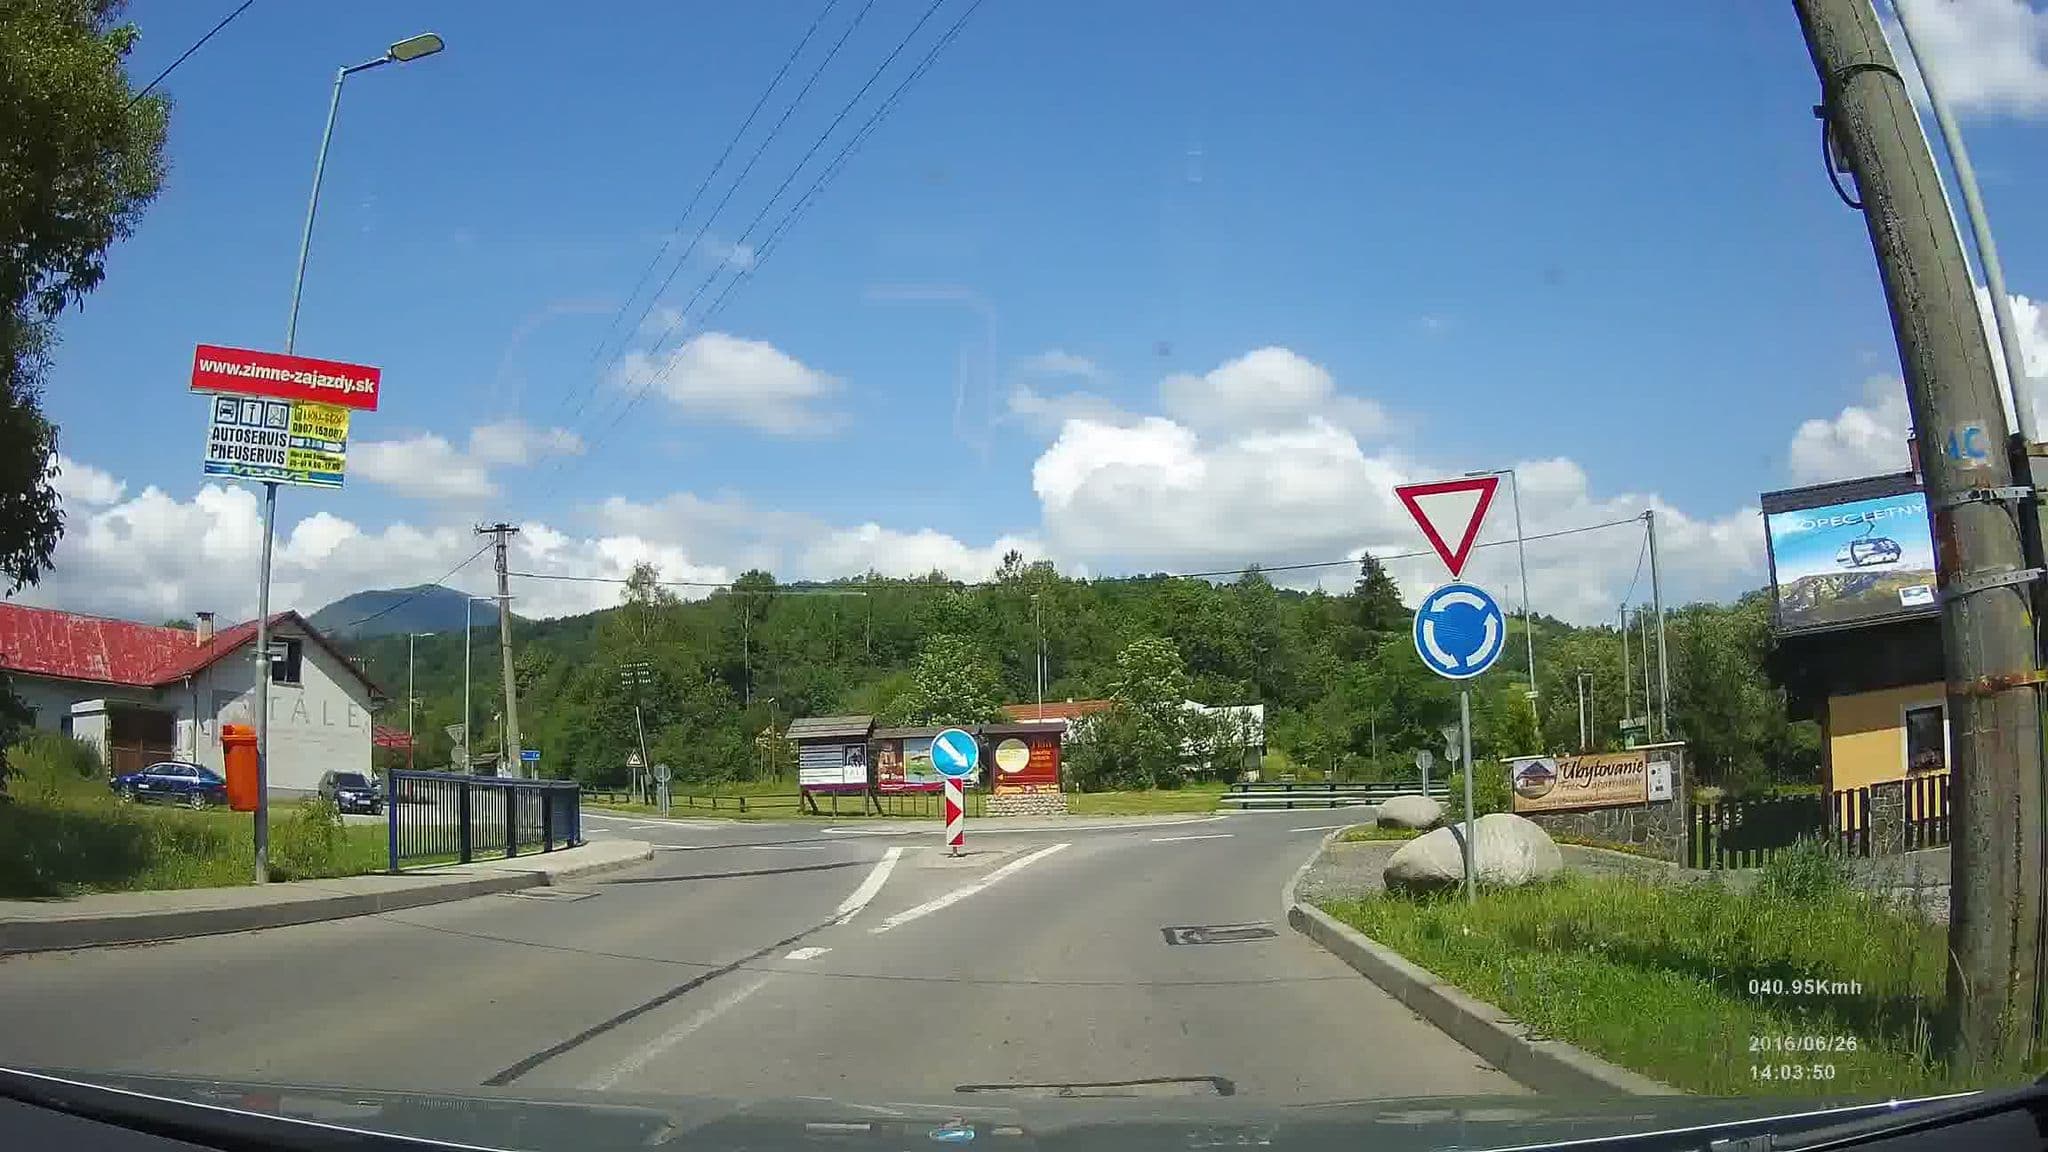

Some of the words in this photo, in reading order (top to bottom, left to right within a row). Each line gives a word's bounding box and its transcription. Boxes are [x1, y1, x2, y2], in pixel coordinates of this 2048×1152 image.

[199, 358, 375, 393] www.zimne-zajazdy.sk
[212, 427, 288, 447] AUTOSERVIS
[210, 445, 286, 465] PNEUSERVIS
[1559, 756, 1644, 788] Ubytovanie
